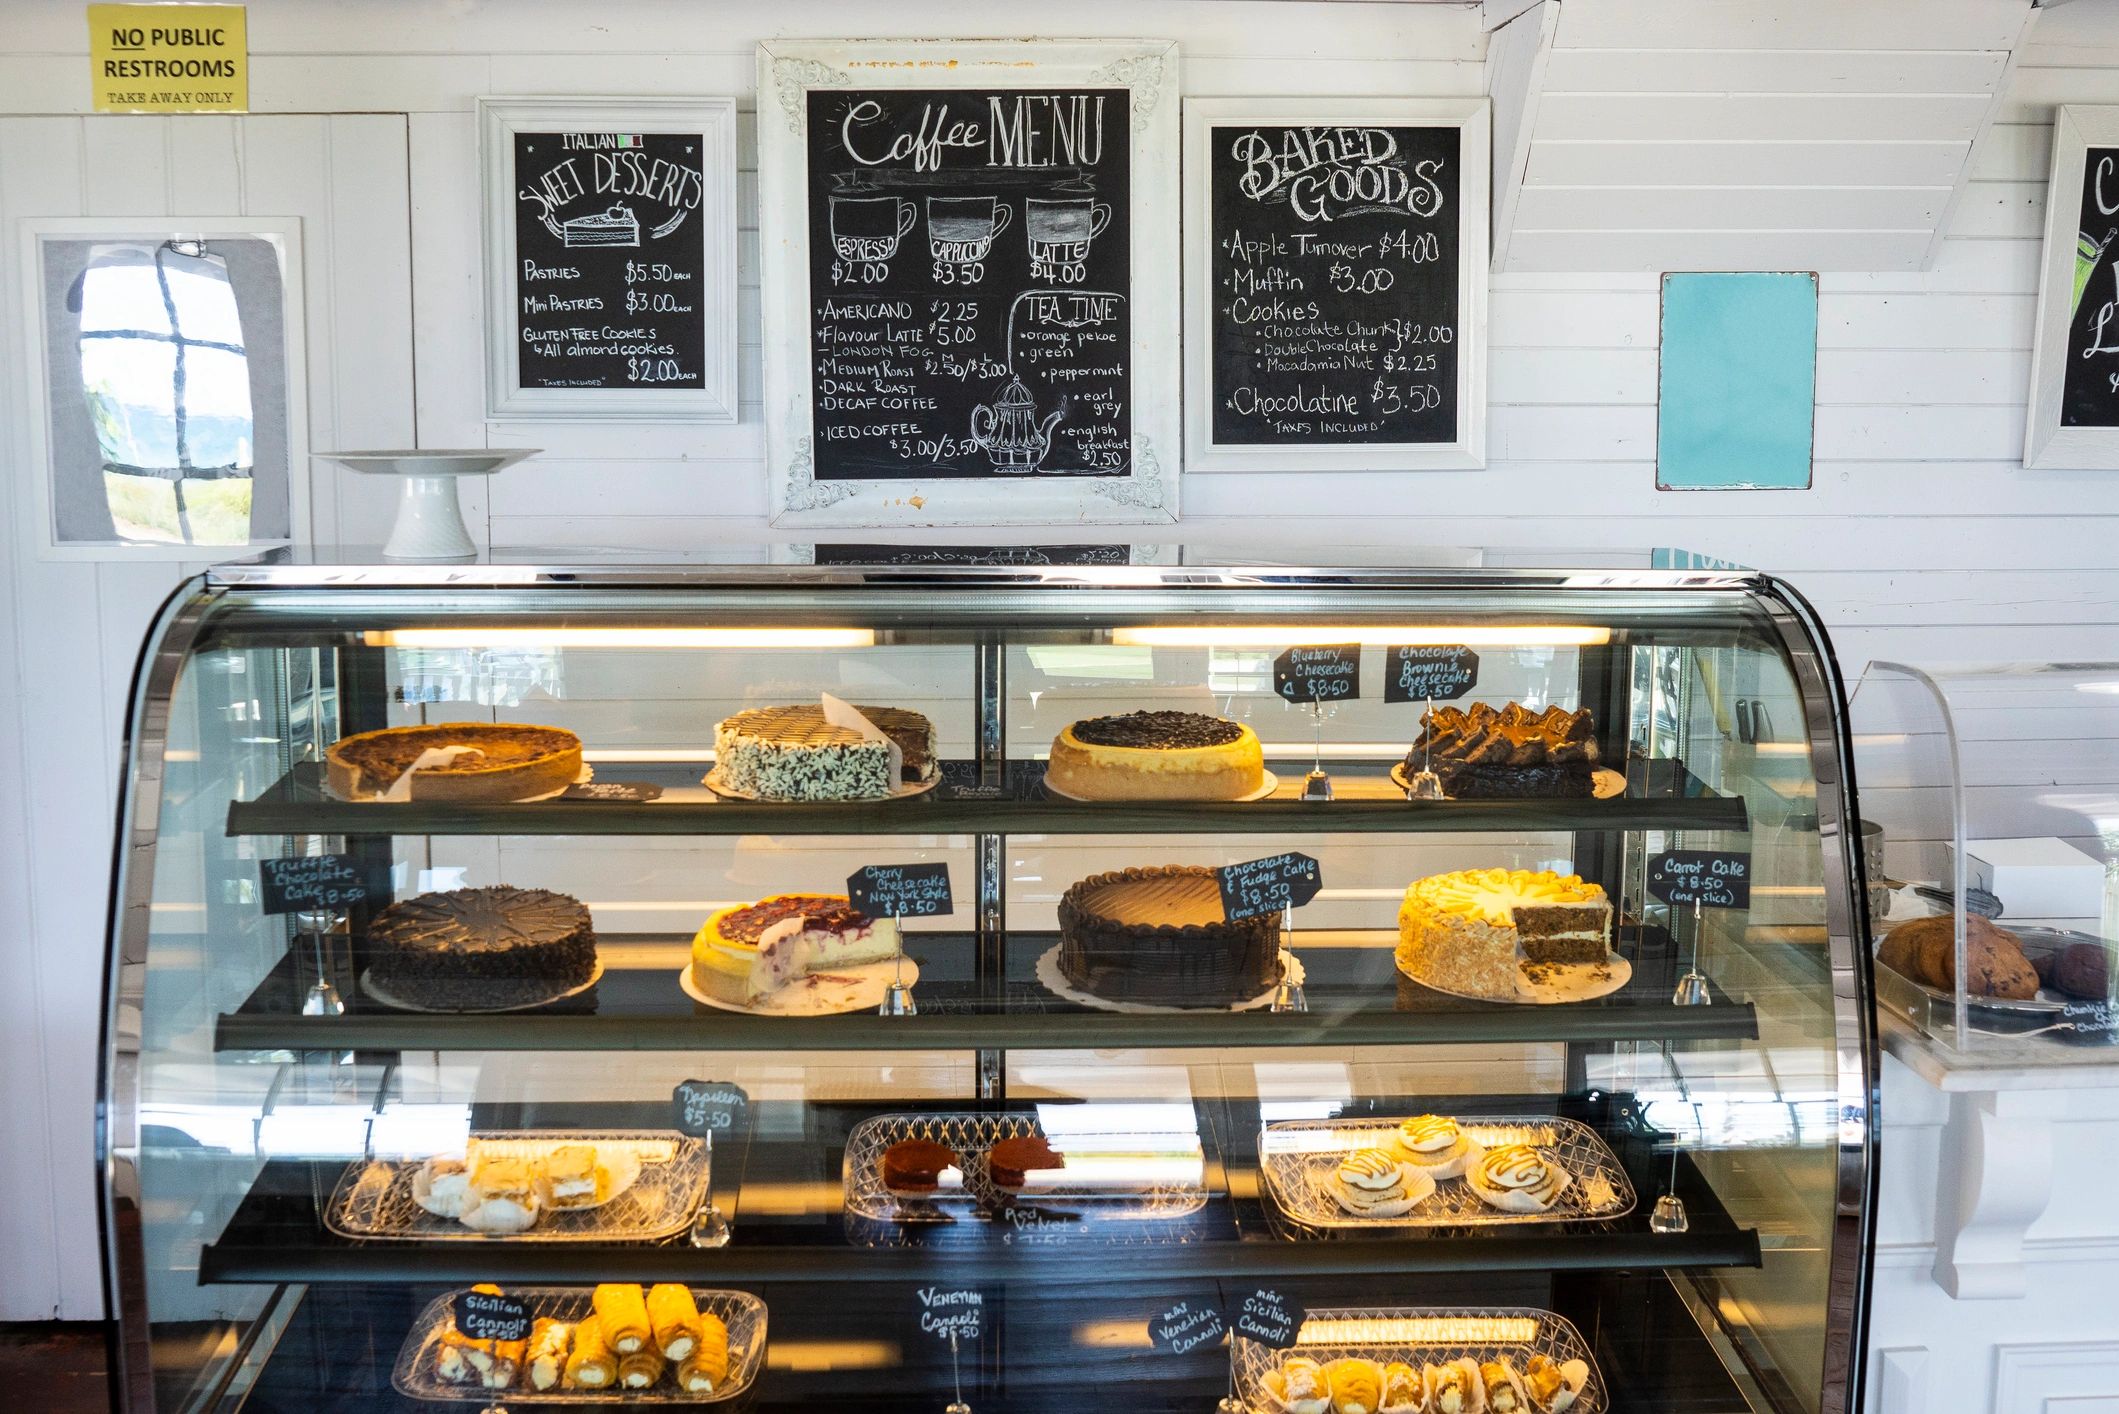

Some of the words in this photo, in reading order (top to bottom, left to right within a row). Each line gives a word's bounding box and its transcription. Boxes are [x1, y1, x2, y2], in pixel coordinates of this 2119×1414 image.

[112, 28, 145, 47] NO
[151, 28, 225, 46] PUBLIC
[104, 60, 235, 77] RESTROOMS
[107, 92, 146, 103] TAKE
[150, 92, 192, 103] AWAY
[195, 92, 234, 103] ONLY
[562, 133, 616, 149] ITALIAN
[842, 100, 987, 173] Coffee
[986, 96, 1105, 167] MENU
[1232, 126, 1398, 201] BAKED
[519, 158, 585, 221] SWEET
[595, 151, 702, 209] DESSERTS
[1290, 158, 1444, 222] GOODS
[837, 235, 894, 260] ESPRESSO
[932, 235, 990, 260] CAPPUCCINO
[1032, 241, 1085, 260] LATTE
[1231, 229, 1288, 265] Apple
[1290, 233, 1372, 260] Turnover
[1379, 229, 1440, 263] $4.00
[625, 259, 673, 285] $5.50
[673, 272, 691, 281] EACH
[832, 262, 889, 286] $2.00
[932, 262, 984, 286] $3.50
[1030, 261, 1086, 285] $4.00
[1234, 266, 1304, 296] Muffin
[1329, 261, 1394, 294] $3.00
[625, 288, 674, 315] $3.00
[673, 304, 692, 313] EACH
[822, 299, 912, 321] AMERICANO
[930, 300, 978, 323] $2.25
[1025, 296, 1062, 321] TEA
[1068, 297, 1118, 321] TIME
[1232, 297, 1320, 323] Cookies
[523, 327, 569, 342] GLUTEN
[572, 327, 598, 340] FREE
[823, 325, 879, 343] Flavour
[887, 323, 923, 342] LATTE
[929, 321, 976, 346] $5.00
[1027, 331, 1071, 349] orange
[1077, 332, 1117, 347] pekoe
[1264, 320, 1343, 337] Chocolate
[1346, 320, 1397, 336] Chunk
[1403, 320, 1453, 344] $2.00
[544, 342, 561, 357] All
[566, 342, 618, 356] almond
[833, 345, 894, 357] LONDON
[900, 345, 934, 358] FOG
[1030, 348, 1074, 363] green
[1264, 343, 1307, 356] Double
[1306, 338, 1379, 353] Chocolate
[627, 356, 679, 382] $2.00
[678, 372, 697, 381] EACH
[822, 358, 880, 377] MEDIUM
[884, 359, 914, 377] ROAST
[1267, 356, 1341, 373] Macadamia
[1344, 355, 1375, 371] Nut
[1383, 352, 1436, 373] $2.25
[1050, 363, 1124, 384] peppermint
[824, 379, 866, 394] DARK
[872, 379, 916, 395] ROAST
[1084, 387, 1113, 400] earl
[1234, 384, 1359, 416] Chocolatine
[1371, 376, 1440, 415] $3.50
[824, 397, 877, 411] DECAF
[882, 398, 937, 410] COFFEE
[1094, 402, 1121, 419] grey
[826, 426, 860, 441] ICED
[864, 423, 922, 436] COFFEE
[1068, 423, 1117, 442] english
[1077, 440, 1130, 450] breakfast
[1082, 451, 1121, 466] $2.50
[1291, 648, 1342, 664] Blueberry
[1399, 646, 1469, 661] Chocolate
[1295, 660, 1354, 677] Cheesecake
[1403, 660, 1458, 676] Brownie
[1307, 678, 1349, 697] $8.50
[1399, 670, 1470, 687] Cheesecake
[1408, 684, 1453, 698] $8.50
[275, 866, 355, 886] Chocolate
[865, 867, 902, 880] Cherry
[1224, 855, 1295, 878] Chocolate
[1240, 871, 1277, 888] Fudge
[1283, 860, 1315, 877] Cake
[1665, 858, 1704, 873] Carrot
[1712, 859, 1745, 876] Cake
[877, 875, 946, 890] Cheesecake
[1676, 875, 1723, 889] $8.50
[285, 884, 324, 900] Cake
[317, 888, 366, 905] $8.50
[1241, 883, 1290, 906] $8.50
[1670, 889, 1693, 901] (one
[1703, 889, 1734, 905] slice)
[684, 1106, 731, 1128] $5.50
[1005, 1207, 1037, 1220] Red
[466, 1295, 523, 1315] Sicilian
[1242, 1298, 1292, 1325] Sicilian
[466, 1314, 528, 1332] Cannoli
[921, 1309, 979, 1333] Cannoli
[1159, 1308, 1216, 1340] Venetian
[1239, 1315, 1290, 1342] Cannoli
[1172, 1318, 1223, 1354] Cannoli
